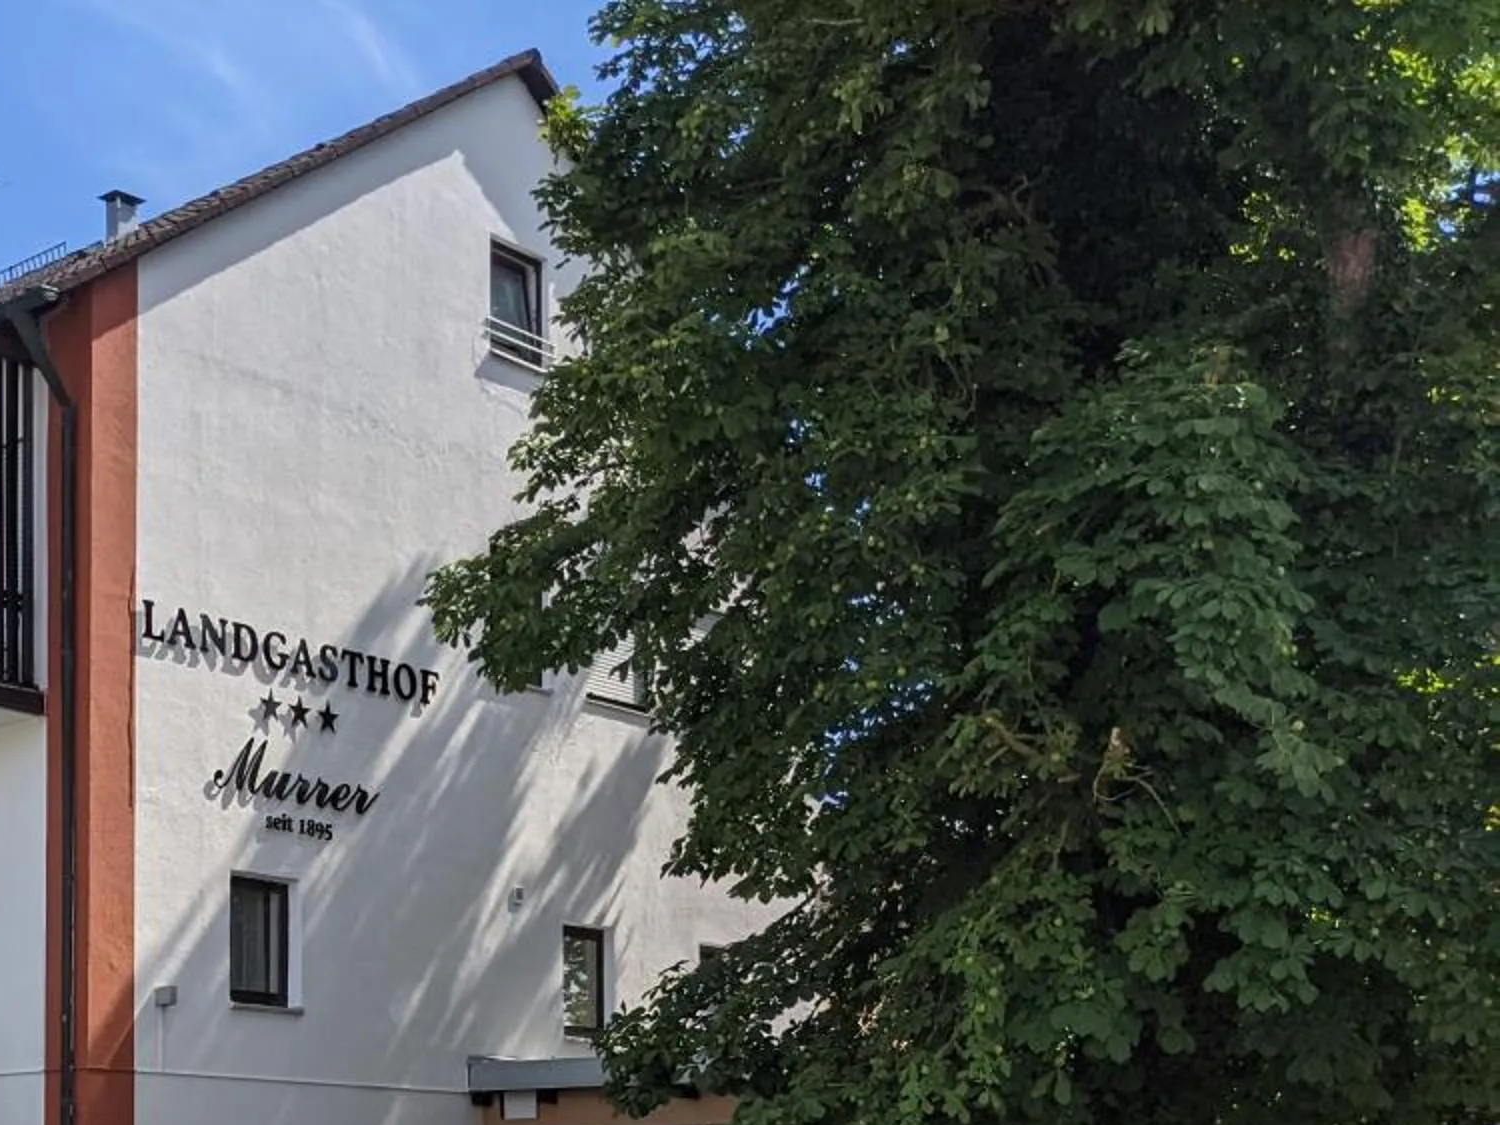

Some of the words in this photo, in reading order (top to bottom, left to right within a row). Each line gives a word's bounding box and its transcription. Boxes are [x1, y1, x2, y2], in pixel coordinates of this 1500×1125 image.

[141, 599, 440, 705] LANDGASTHOF
[213, 737, 381, 815] Murrer
[265, 813, 293, 833] seit
[299, 819, 333, 841] 1895
